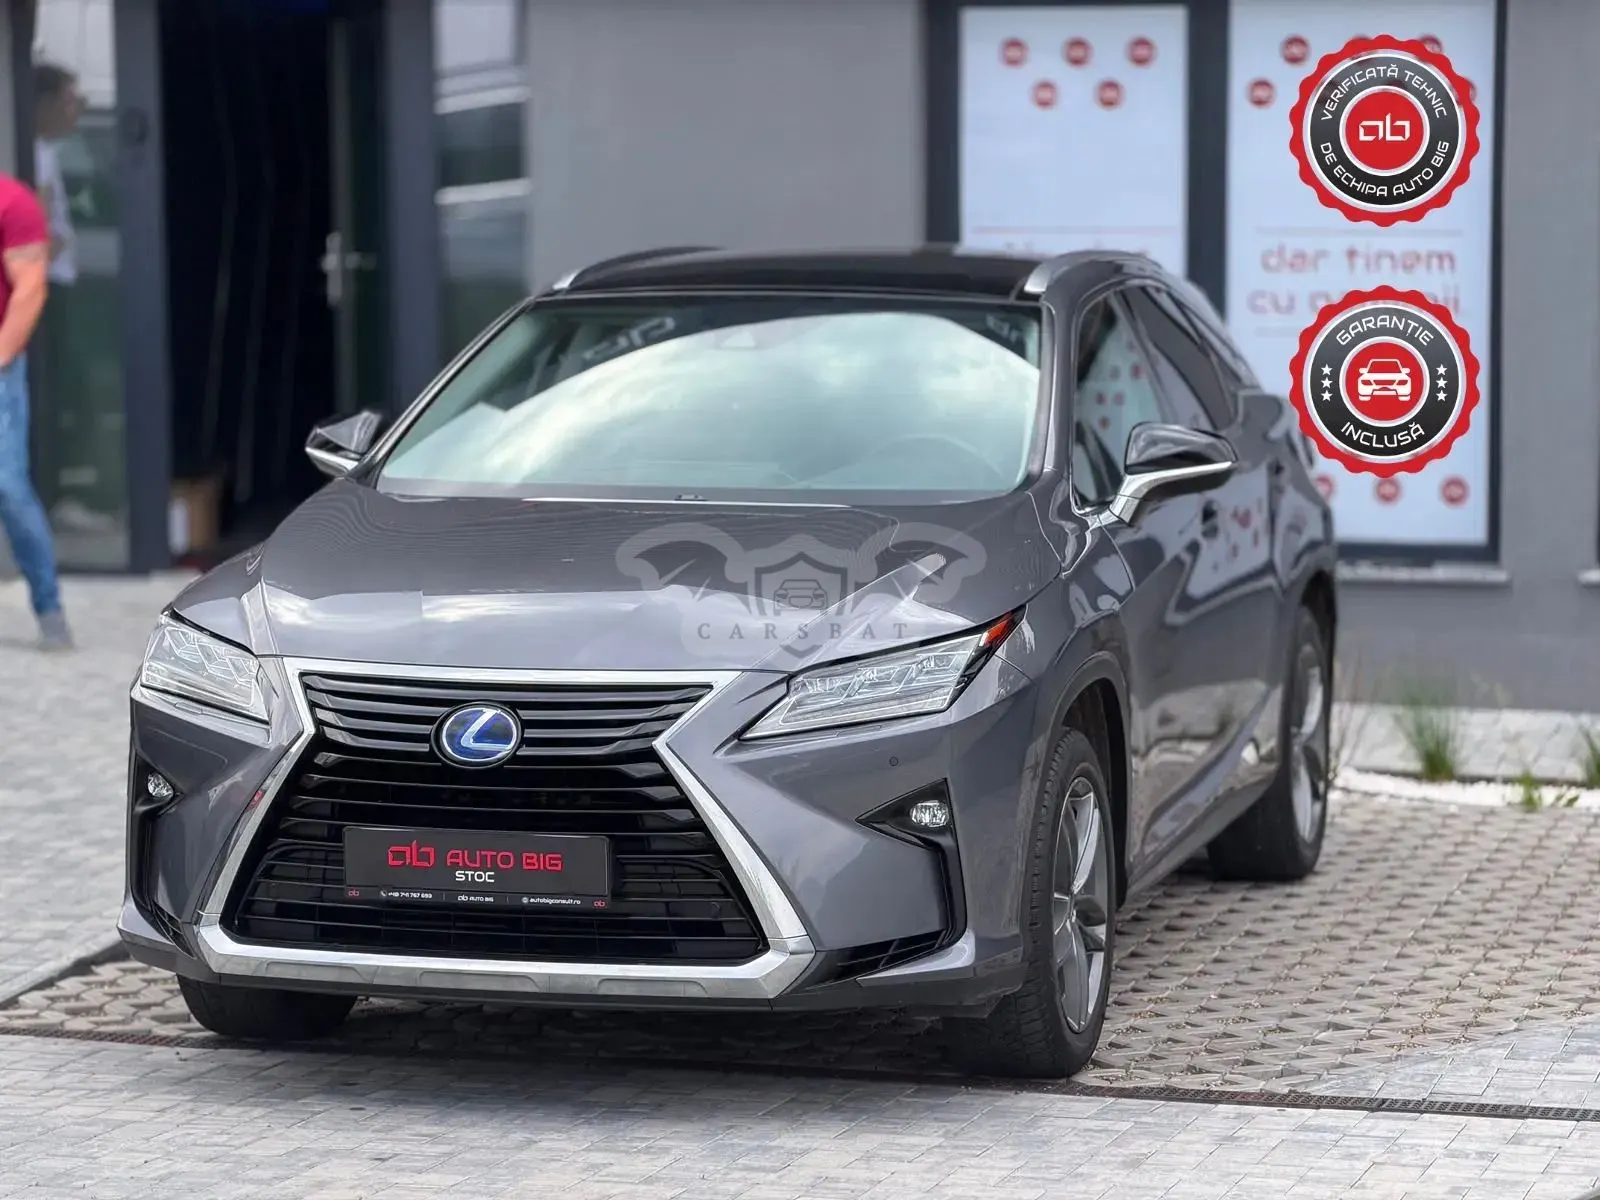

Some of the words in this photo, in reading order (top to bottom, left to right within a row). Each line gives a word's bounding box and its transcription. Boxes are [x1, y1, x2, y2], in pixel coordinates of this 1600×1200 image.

[1260, 241, 1329, 274] dar
[446, 849, 515, 869] AUTO
[522, 852, 563, 872] BIG
[455, 870, 496, 883] STOC
